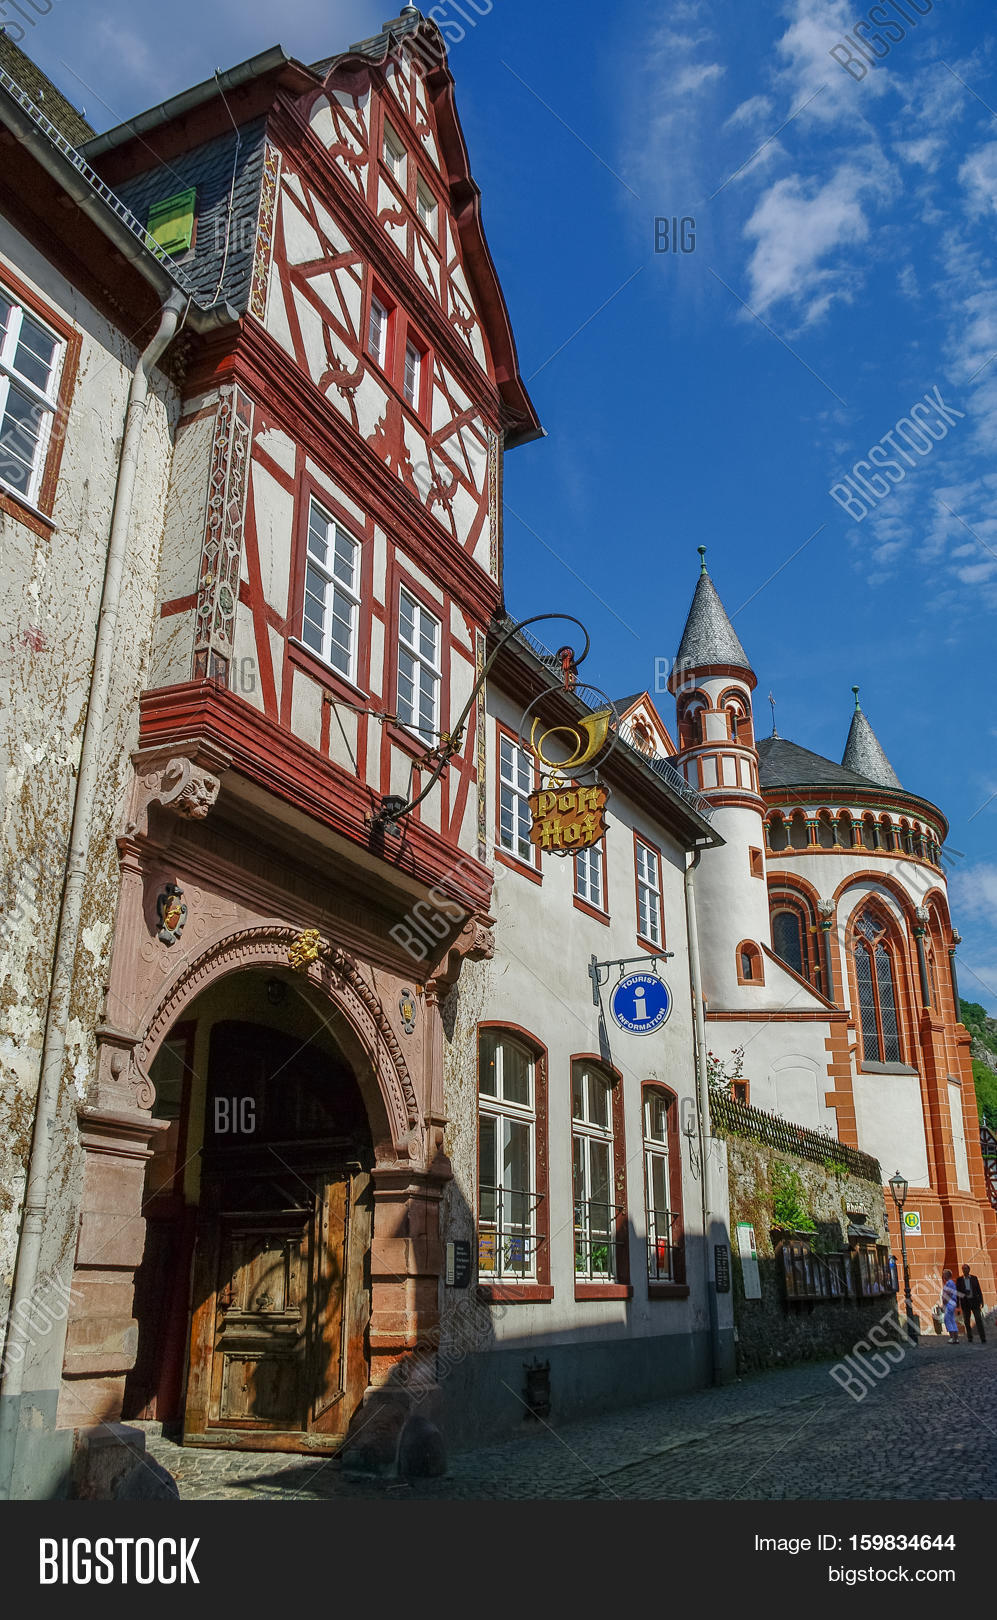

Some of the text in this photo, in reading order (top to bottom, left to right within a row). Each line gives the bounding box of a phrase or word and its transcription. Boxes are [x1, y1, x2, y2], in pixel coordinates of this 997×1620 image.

[540, 814, 598, 848] Hof
[621, 976, 658, 990] TOURIST
[617, 1007, 666, 1031] INFORMATION
